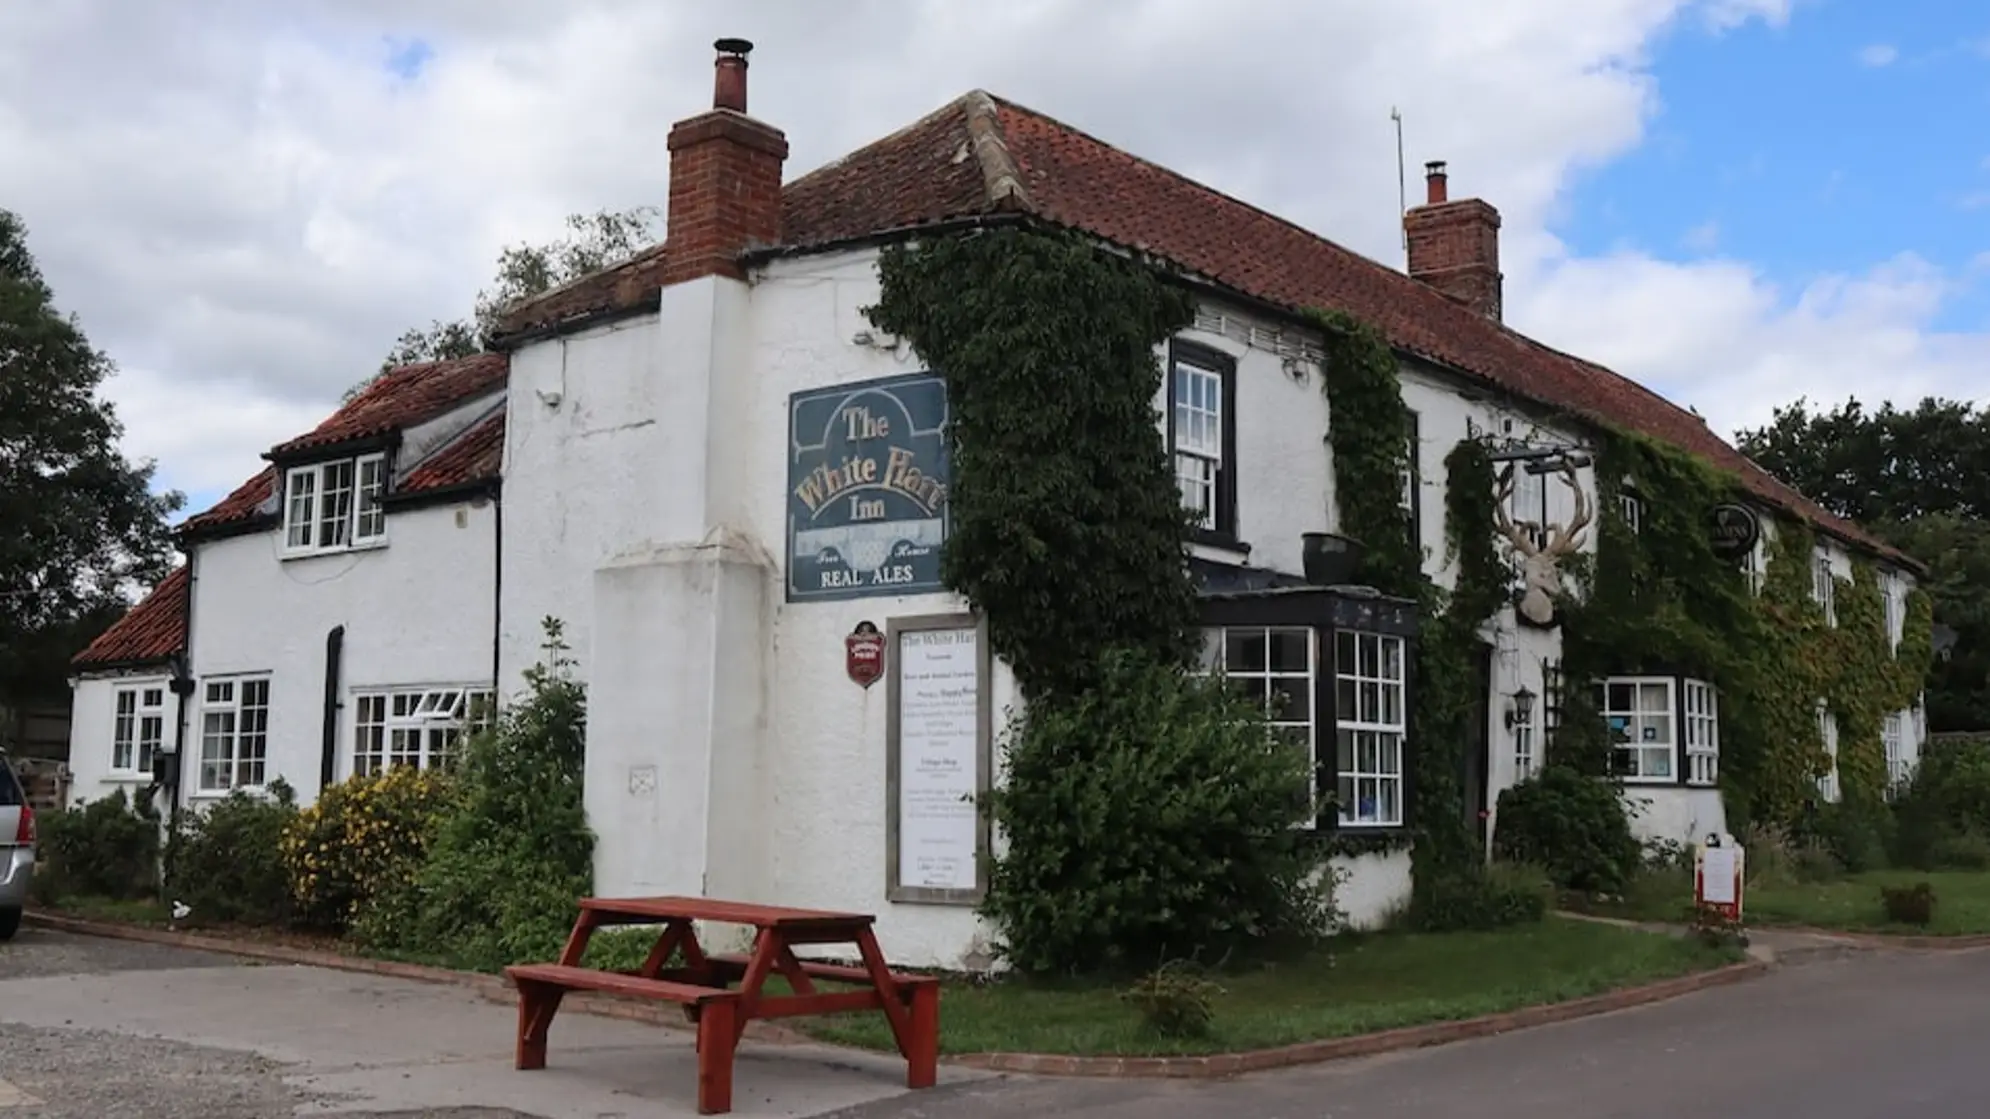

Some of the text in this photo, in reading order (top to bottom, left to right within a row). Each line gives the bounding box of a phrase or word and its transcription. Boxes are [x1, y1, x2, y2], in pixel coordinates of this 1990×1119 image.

[842, 405, 889, 441] The
[794, 445, 948, 511] White Hart
[849, 494, 885, 521] Inn
[820, 564, 914, 588] REAL ALES
